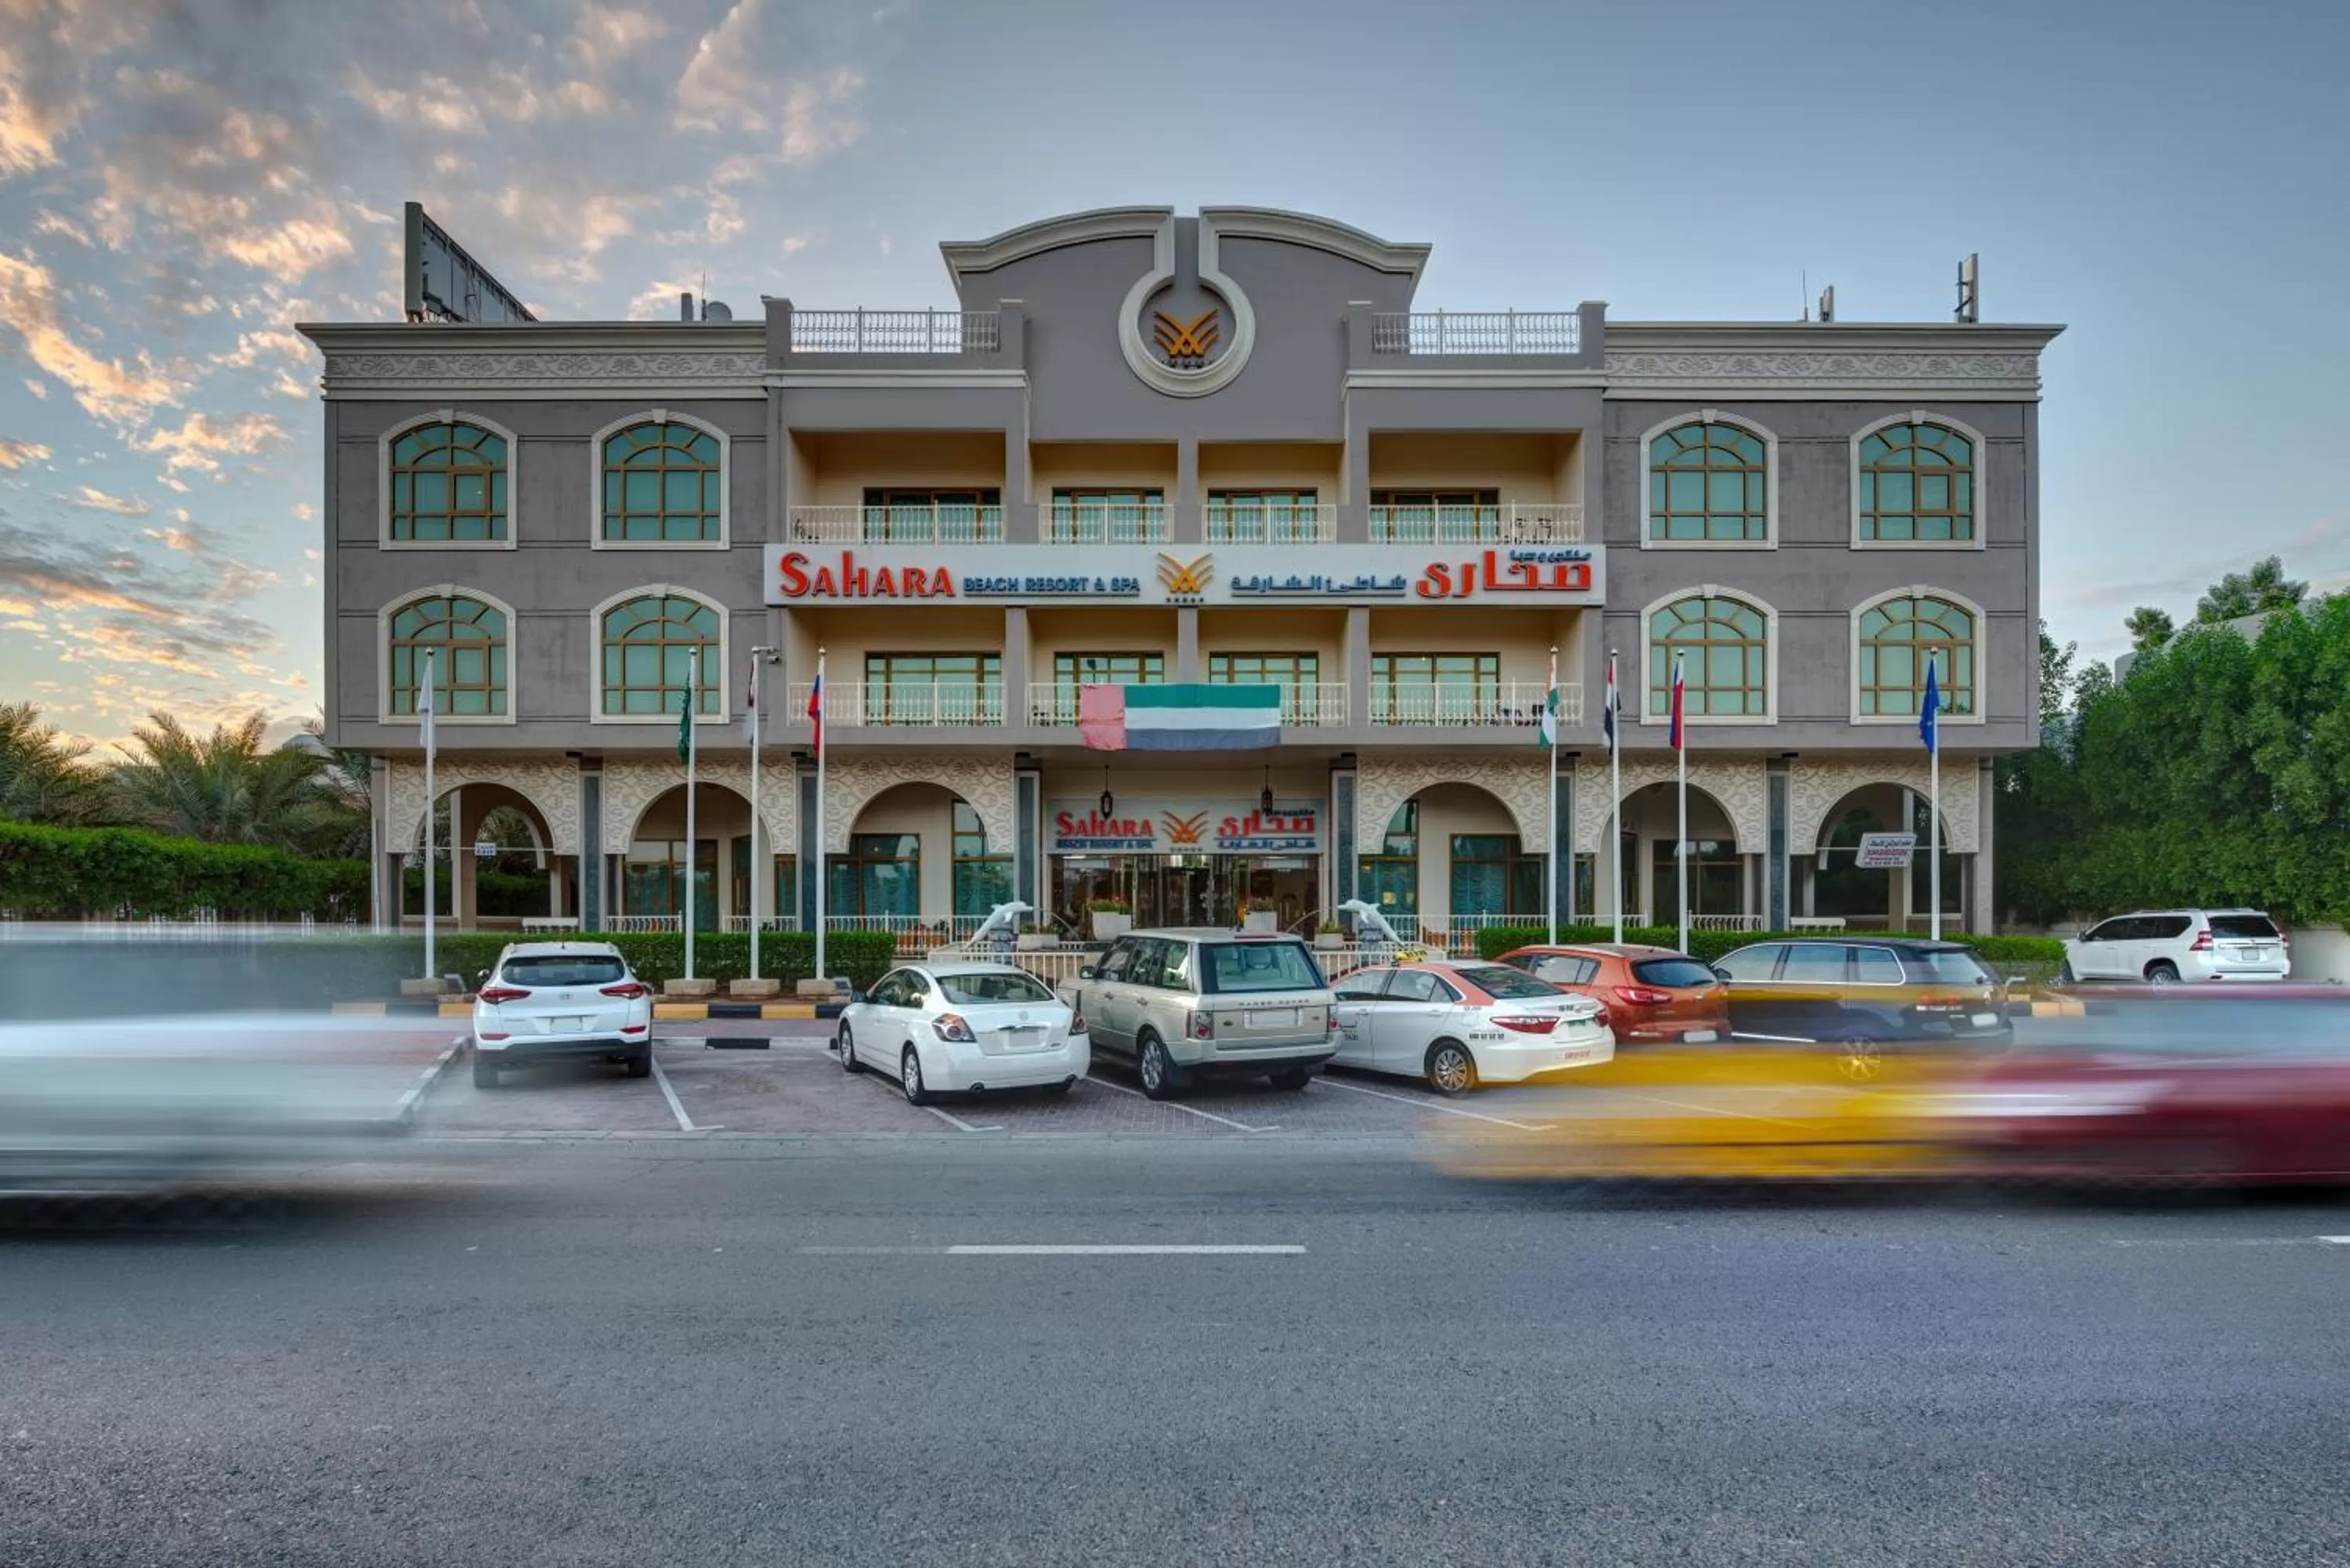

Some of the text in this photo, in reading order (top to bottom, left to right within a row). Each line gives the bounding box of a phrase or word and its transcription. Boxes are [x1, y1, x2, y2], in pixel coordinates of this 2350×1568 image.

[780, 551, 956, 597] SAHARA
[964, 576, 1141, 592] BEACH RESORT & SPA
[1055, 809, 1155, 837] SAHARA
